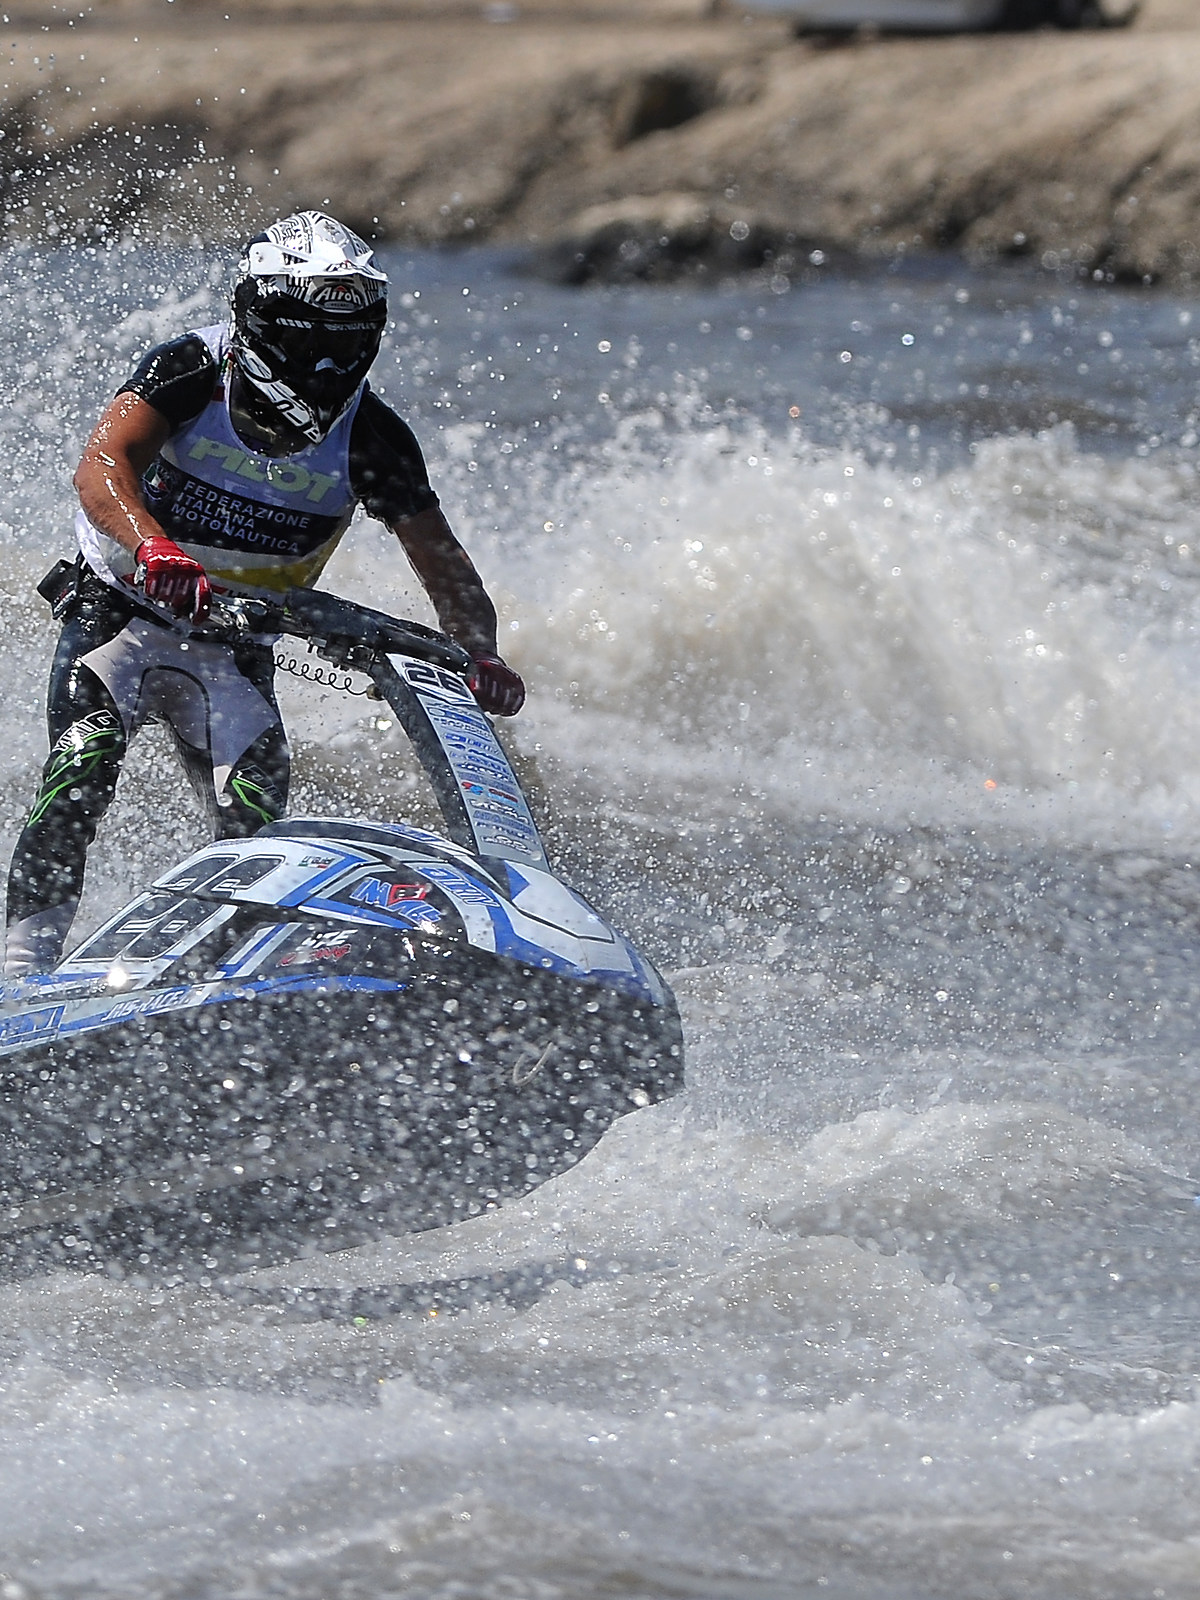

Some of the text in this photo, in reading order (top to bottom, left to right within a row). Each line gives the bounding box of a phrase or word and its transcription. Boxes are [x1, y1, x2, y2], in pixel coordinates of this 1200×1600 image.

[314, 286, 362, 306] Airoh
[188, 436, 339, 503] PILOT
[176, 492, 256, 530] ITALIANA
[183, 480, 311, 529] FEDERAZIONE
[171, 503, 300, 553] MOTONAUTICA
[401, 661, 474, 702] 26
